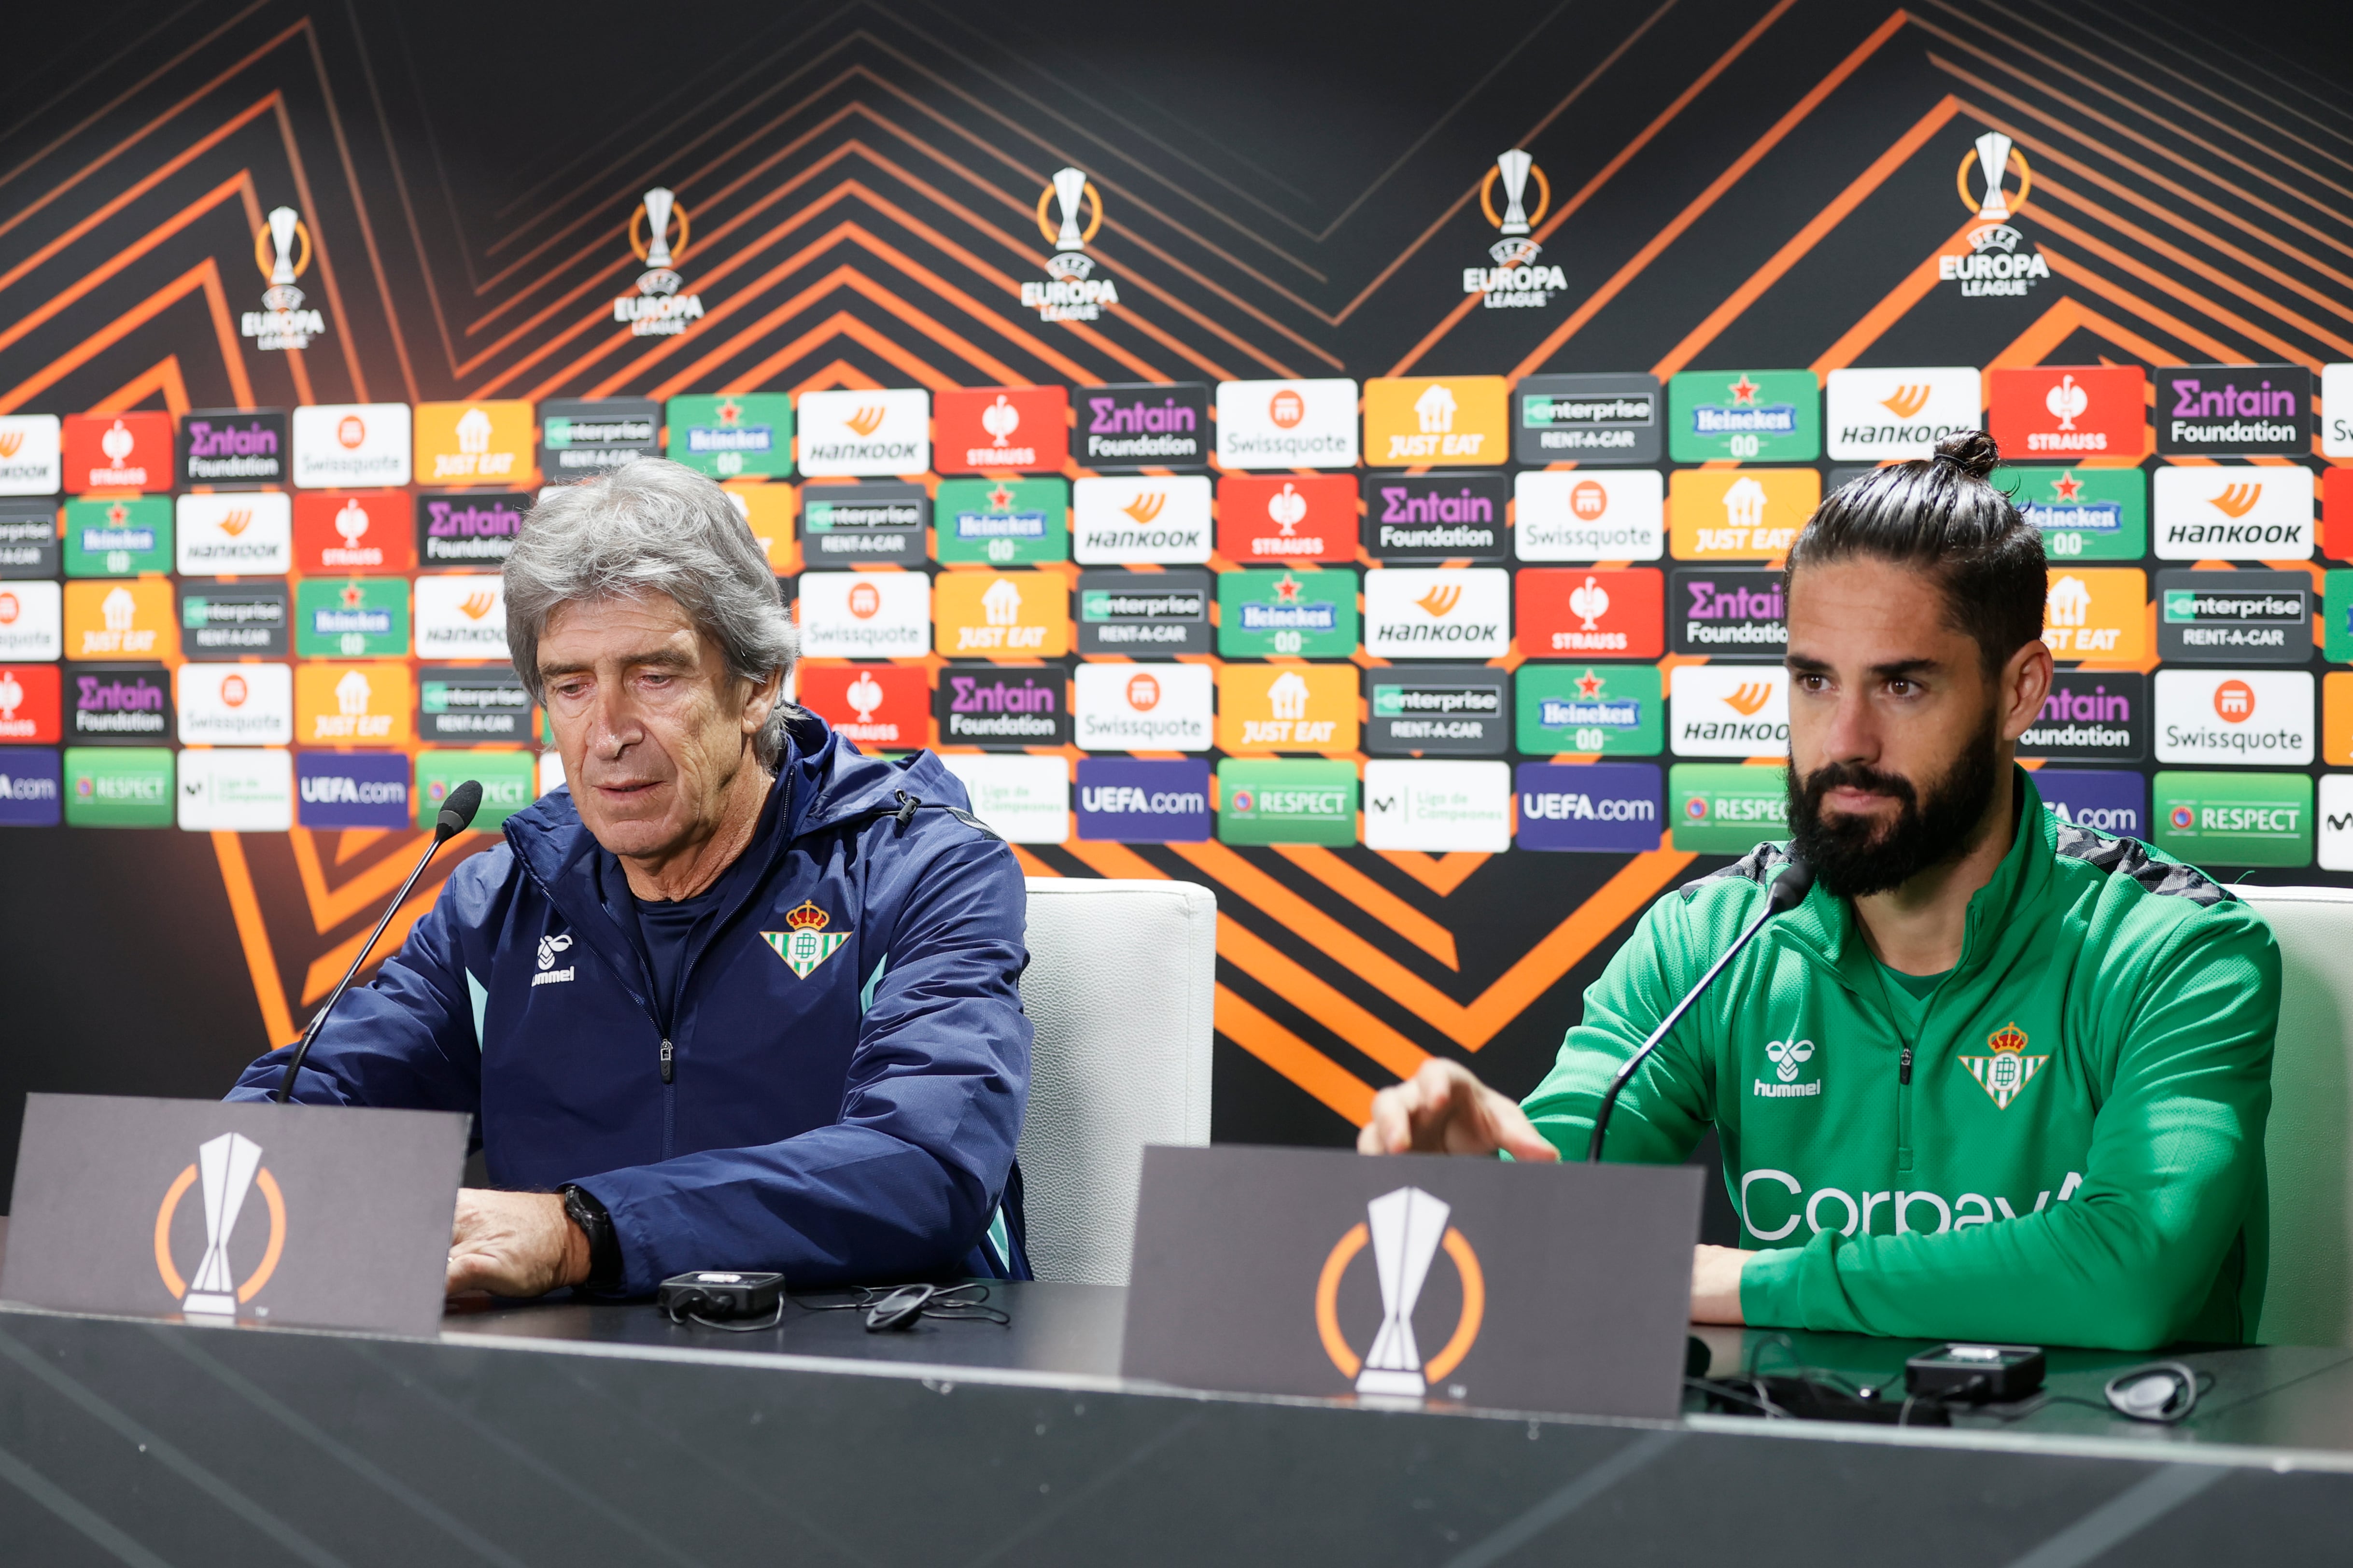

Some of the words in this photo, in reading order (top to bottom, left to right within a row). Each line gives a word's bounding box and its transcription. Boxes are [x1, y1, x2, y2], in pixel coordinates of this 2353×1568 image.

[1939, 253, 2050, 280] EUROPA
[1463, 266, 1568, 293] EUROPA
[1961, 280, 2028, 296] LEAGUE
[1021, 279, 1119, 307] EUROPA
[1484, 291, 1547, 308] LEAGUE
[614, 294, 704, 322] EUROPA
[1040, 304, 1100, 322] LEAGUE
[1531, 399, 1651, 422] enterprise
[1697, 409, 1791, 431] Heineken
[2028, 433, 2107, 451] STRAUSS
[2172, 420, 2296, 443] Foundation
[966, 447, 1036, 466] STRAUSS
[1088, 434, 1197, 457] Foundation
[1227, 433, 1347, 457] Swissquote
[1388, 434, 1440, 459] JUST
[1441, 434, 1485, 457] EAT
[189, 454, 279, 478] Foundation
[434, 454, 475, 478] JUST
[476, 453, 515, 475] EAT
[959, 515, 1043, 536] Heineken
[2019, 506, 2116, 528] Heineken
[1252, 538, 1324, 555] STRAUSS
[1380, 525, 1494, 548] Foundation
[1526, 524, 1651, 551] Swissquote
[1695, 529, 1749, 553] JUST
[1751, 528, 1796, 550] EAT
[322, 548, 383, 566] STRAUSS
[1090, 596, 1200, 617] enterprise
[1244, 606, 1333, 629] Heineken
[2172, 593, 2301, 619] enterprise
[81, 631, 122, 654] JUST
[123, 630, 158, 651] EAT
[809, 623, 918, 645] Swissquote
[957, 627, 1006, 651] JUST
[1007, 626, 1047, 648] EAT
[1552, 632, 1628, 651] STRAUSS
[1687, 621, 1788, 644] Foundatio
[2074, 628, 2121, 651] EAT
[2183, 629, 2284, 647] RENT-A-CAR
[1382, 691, 1498, 713] enterprise
[1544, 701, 1637, 725] Heineken
[2037, 685, 2130, 722] ntain
[314, 715, 356, 740] JUST
[357, 714, 394, 736] EAT
[950, 714, 1056, 736] Foundation
[1085, 714, 1202, 740] Swissquote
[1241, 721, 1293, 745] JUST
[1295, 721, 1337, 743] EAT
[2019, 724, 2130, 746] oundation
[2166, 726, 2303, 754] Swissquote
[97, 776, 165, 799] RESPECT
[300, 777, 407, 804] UEFA.com
[1082, 786, 1205, 814] UEFA.com
[1259, 791, 1348, 814] RESPECT
[1524, 793, 1655, 822] UEFA.com
[1715, 799, 1789, 822] RESPEC
[2202, 808, 2300, 831] RESPECT
[531, 966, 575, 987] ummel
[1754, 1078, 1821, 1098] hummel
